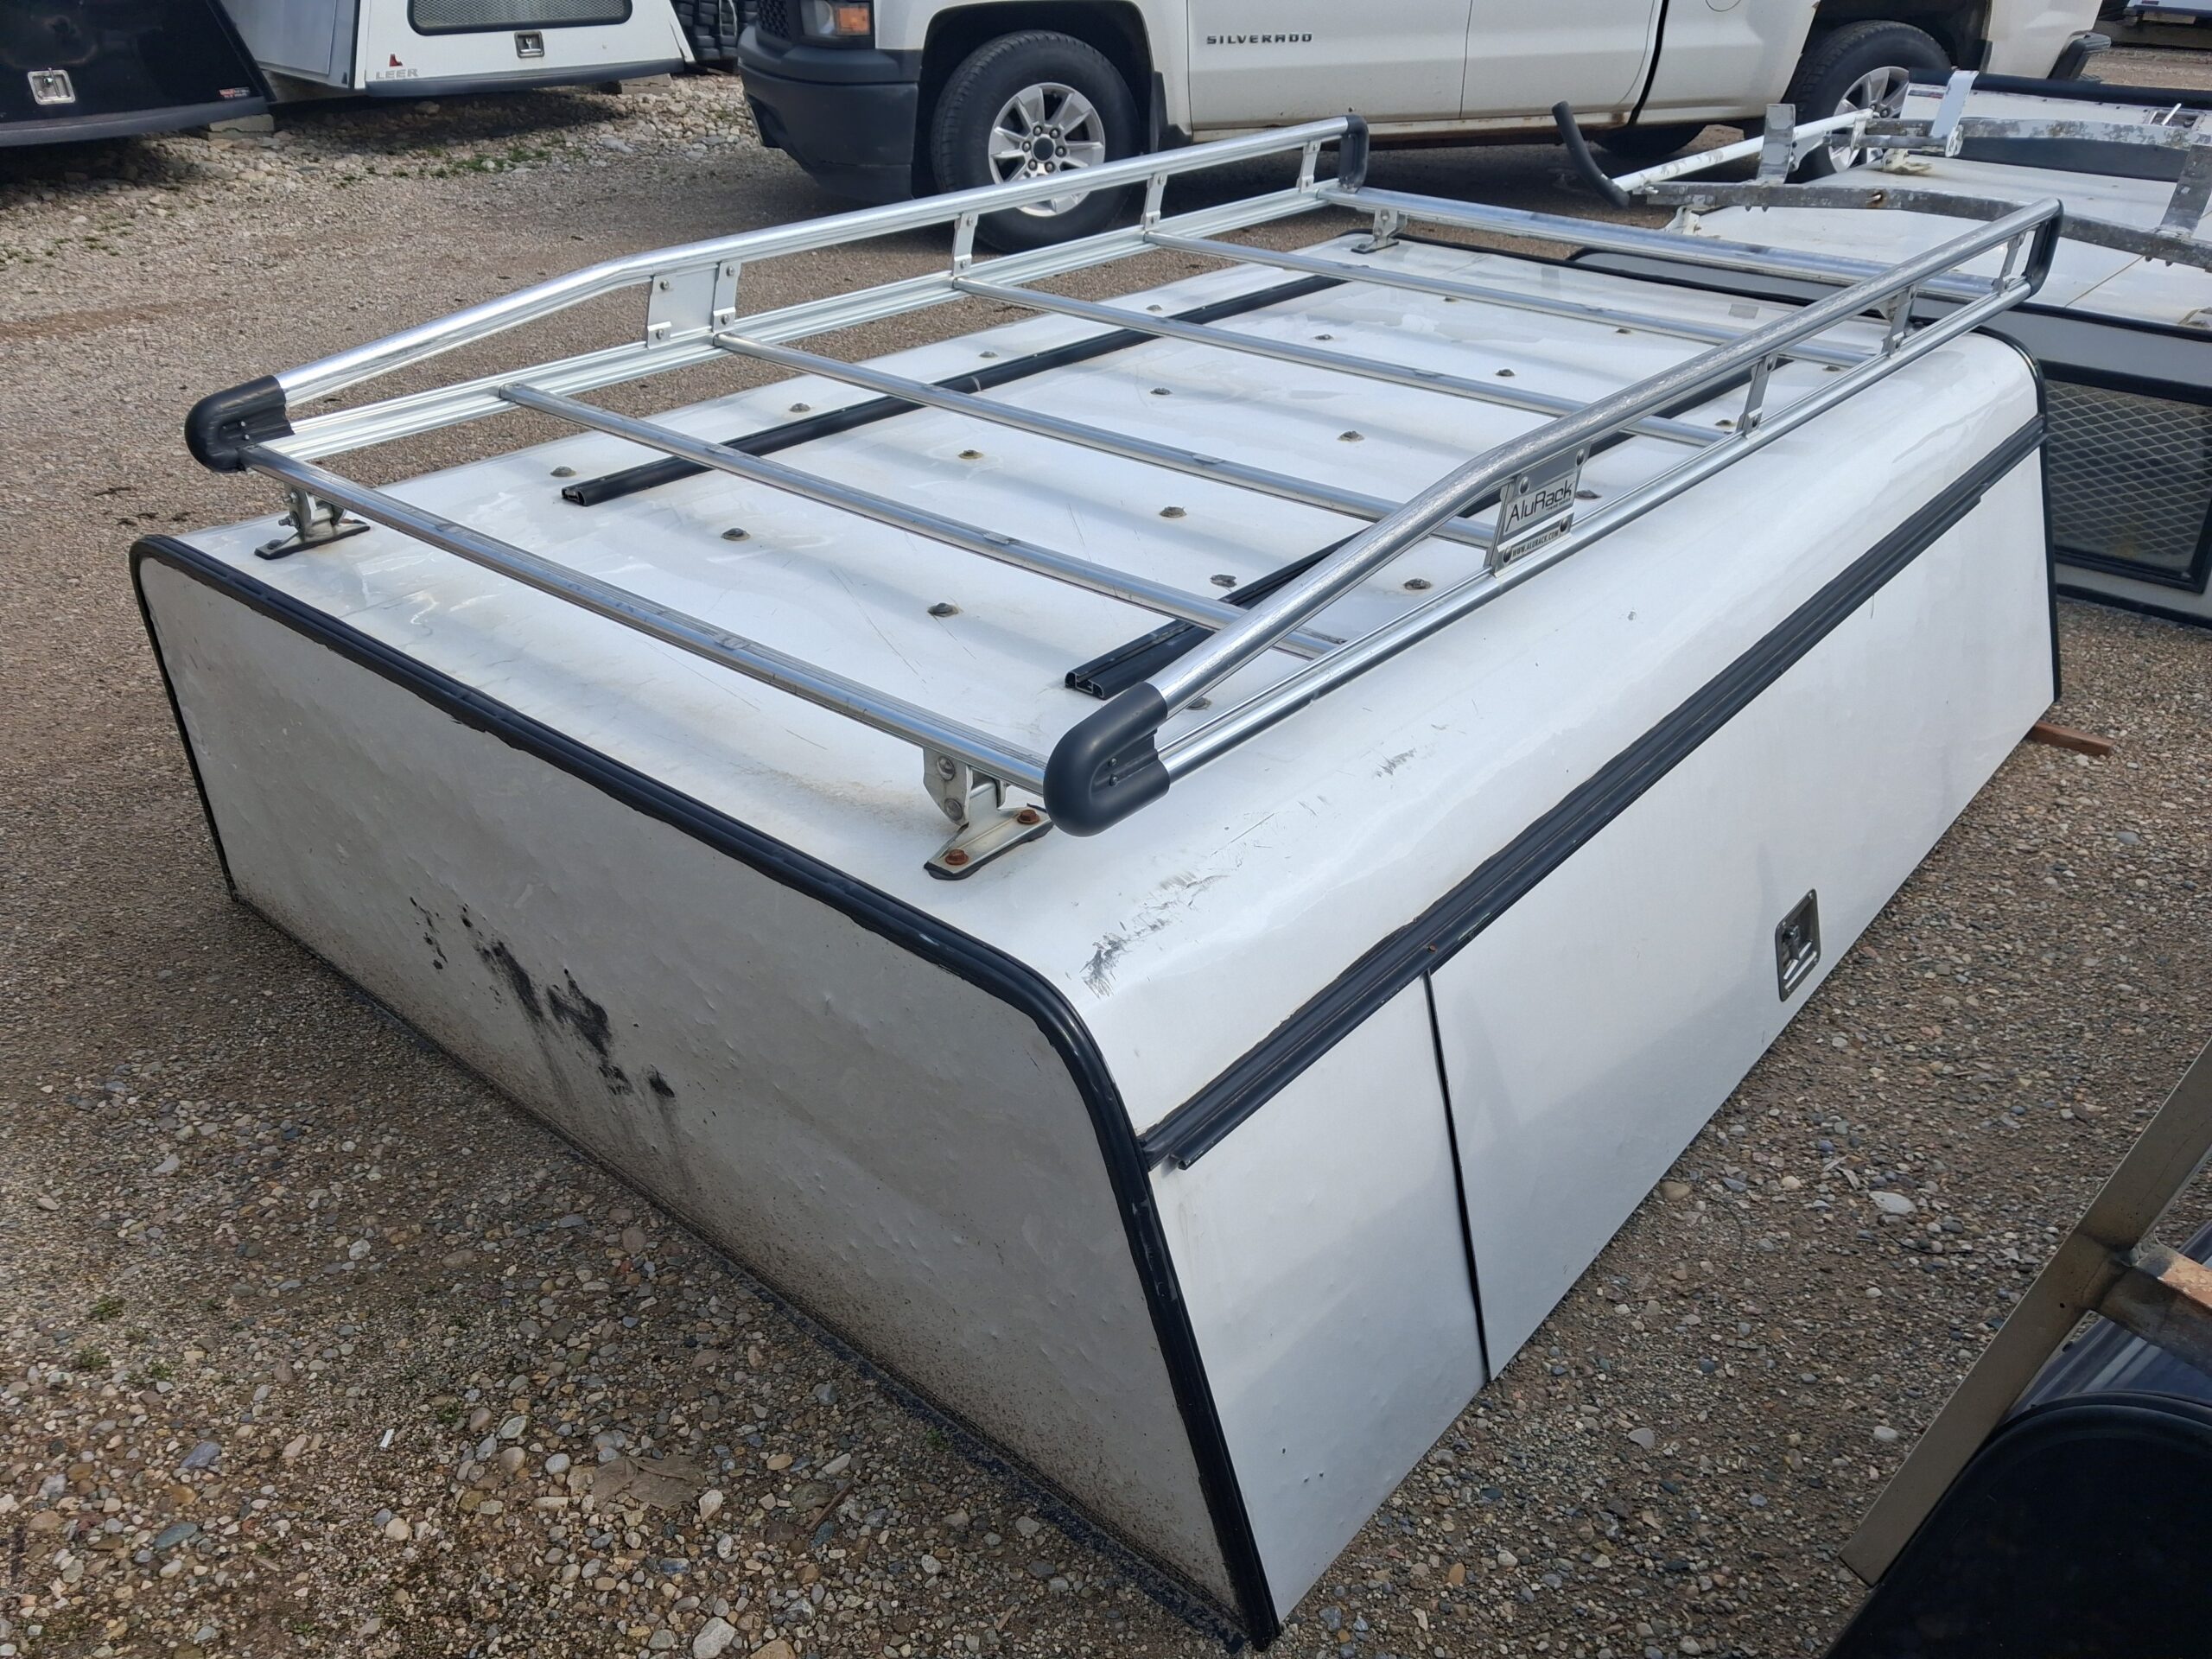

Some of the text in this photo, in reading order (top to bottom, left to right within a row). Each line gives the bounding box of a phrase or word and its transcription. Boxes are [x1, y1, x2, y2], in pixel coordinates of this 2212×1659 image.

[1206, 33, 1313, 44] SILVERADO
[375, 68, 419, 79] LEER
[1505, 480, 1574, 532] AluRack
[1512, 529, 1559, 557] WWW.ALURACK.COM
